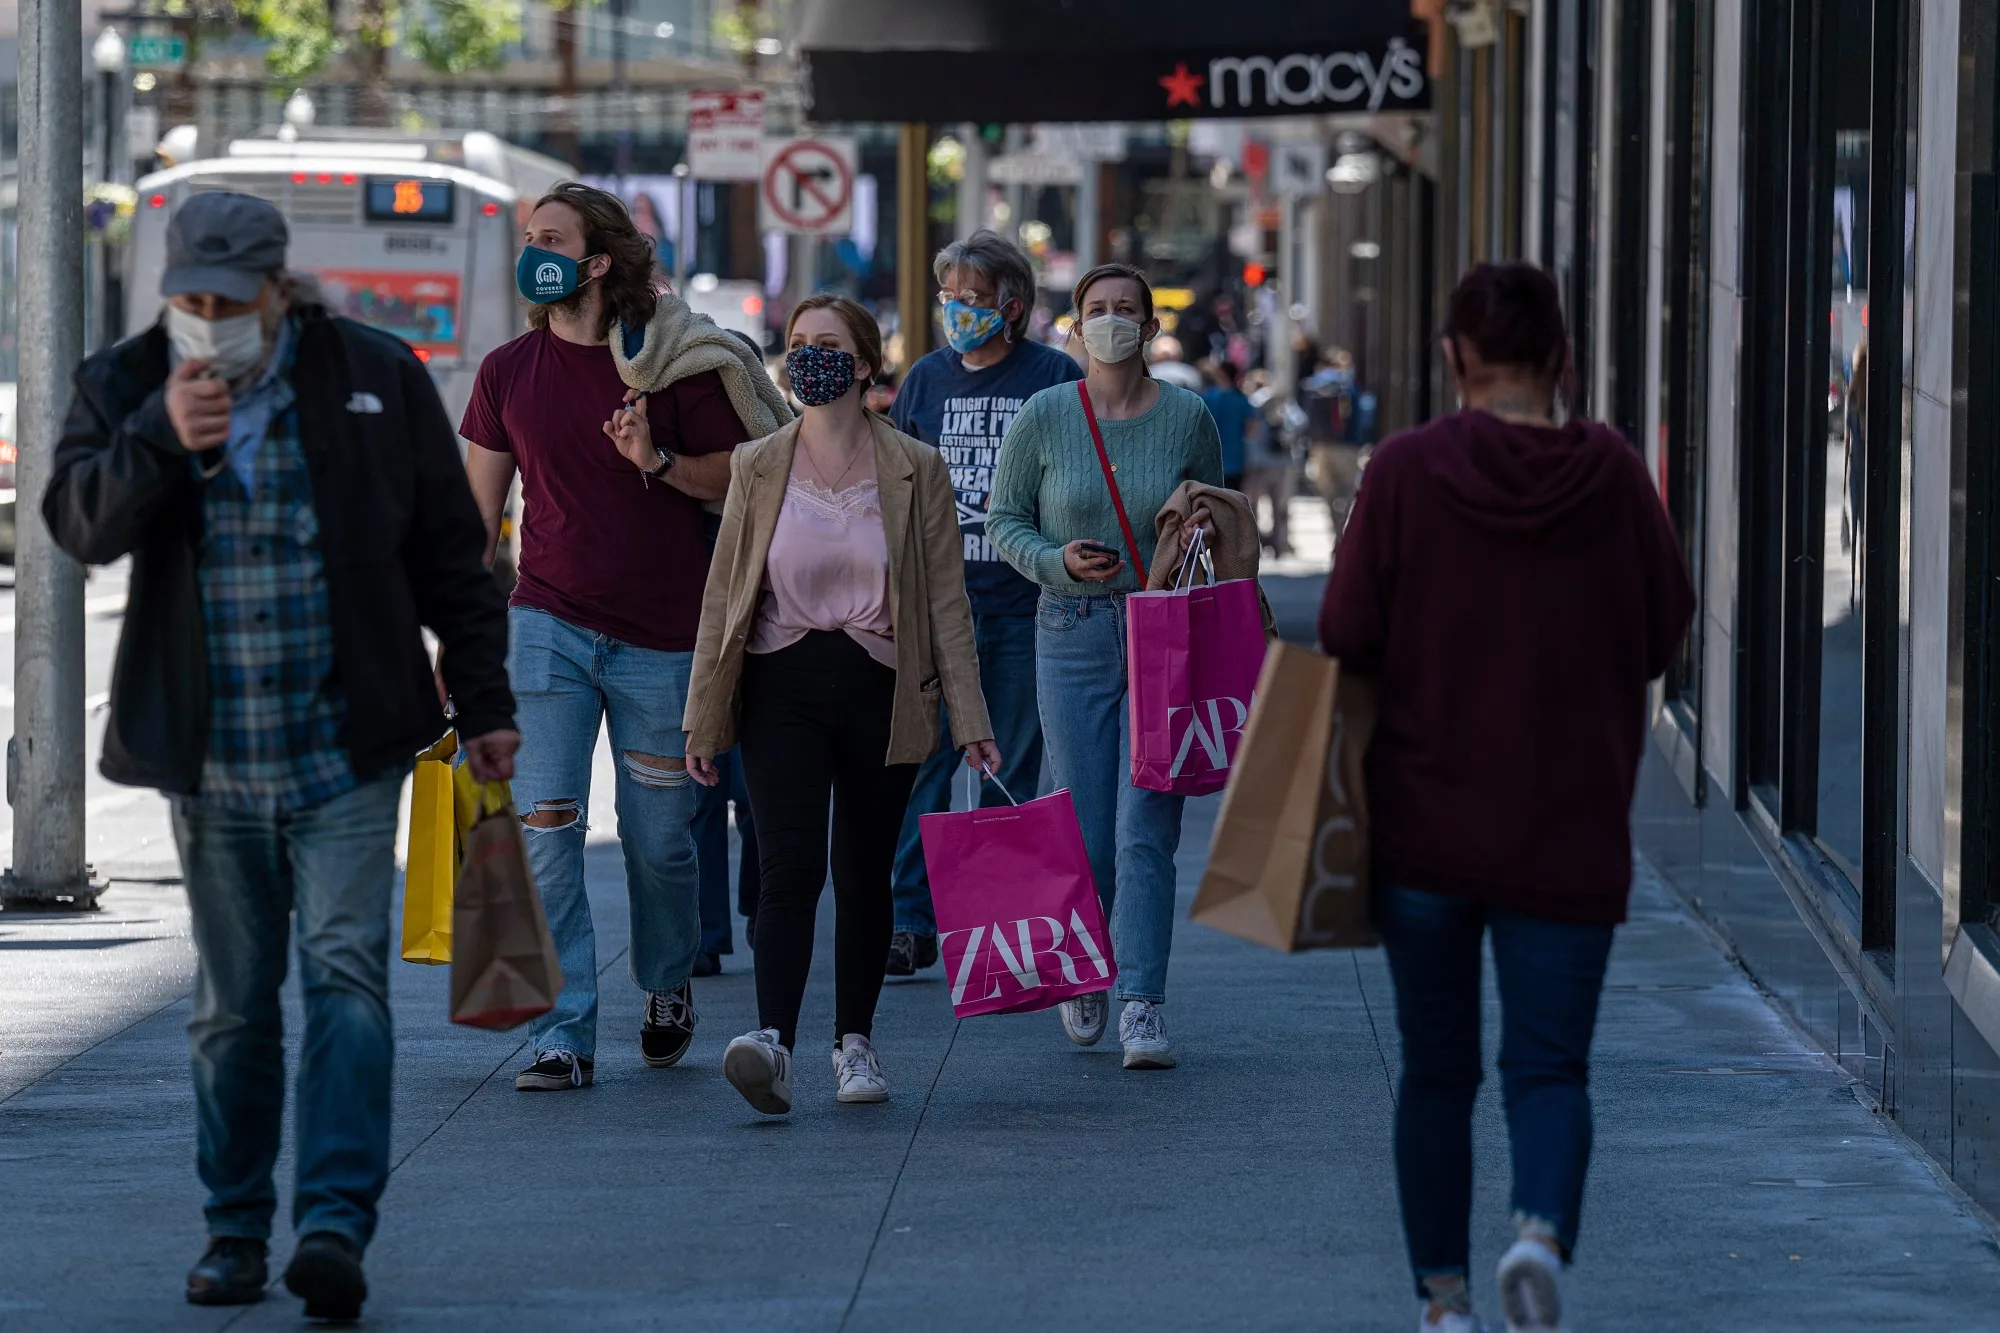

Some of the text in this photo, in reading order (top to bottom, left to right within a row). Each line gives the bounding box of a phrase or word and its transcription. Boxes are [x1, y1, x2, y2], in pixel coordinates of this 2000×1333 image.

[1208, 37, 1424, 113] macy's
[943, 396, 1023, 412] I MIGHT LOOK
[941, 411, 986, 435] LIKE
[939, 434, 988, 448] LISTENING
[988, 436, 1000, 448] TO
[939, 445, 973, 465] BUT
[974, 447, 993, 467] IN
[961, 490, 981, 505] I'M
[1167, 690, 1257, 779] ZAR
[938, 907, 1109, 1006] ZARA
